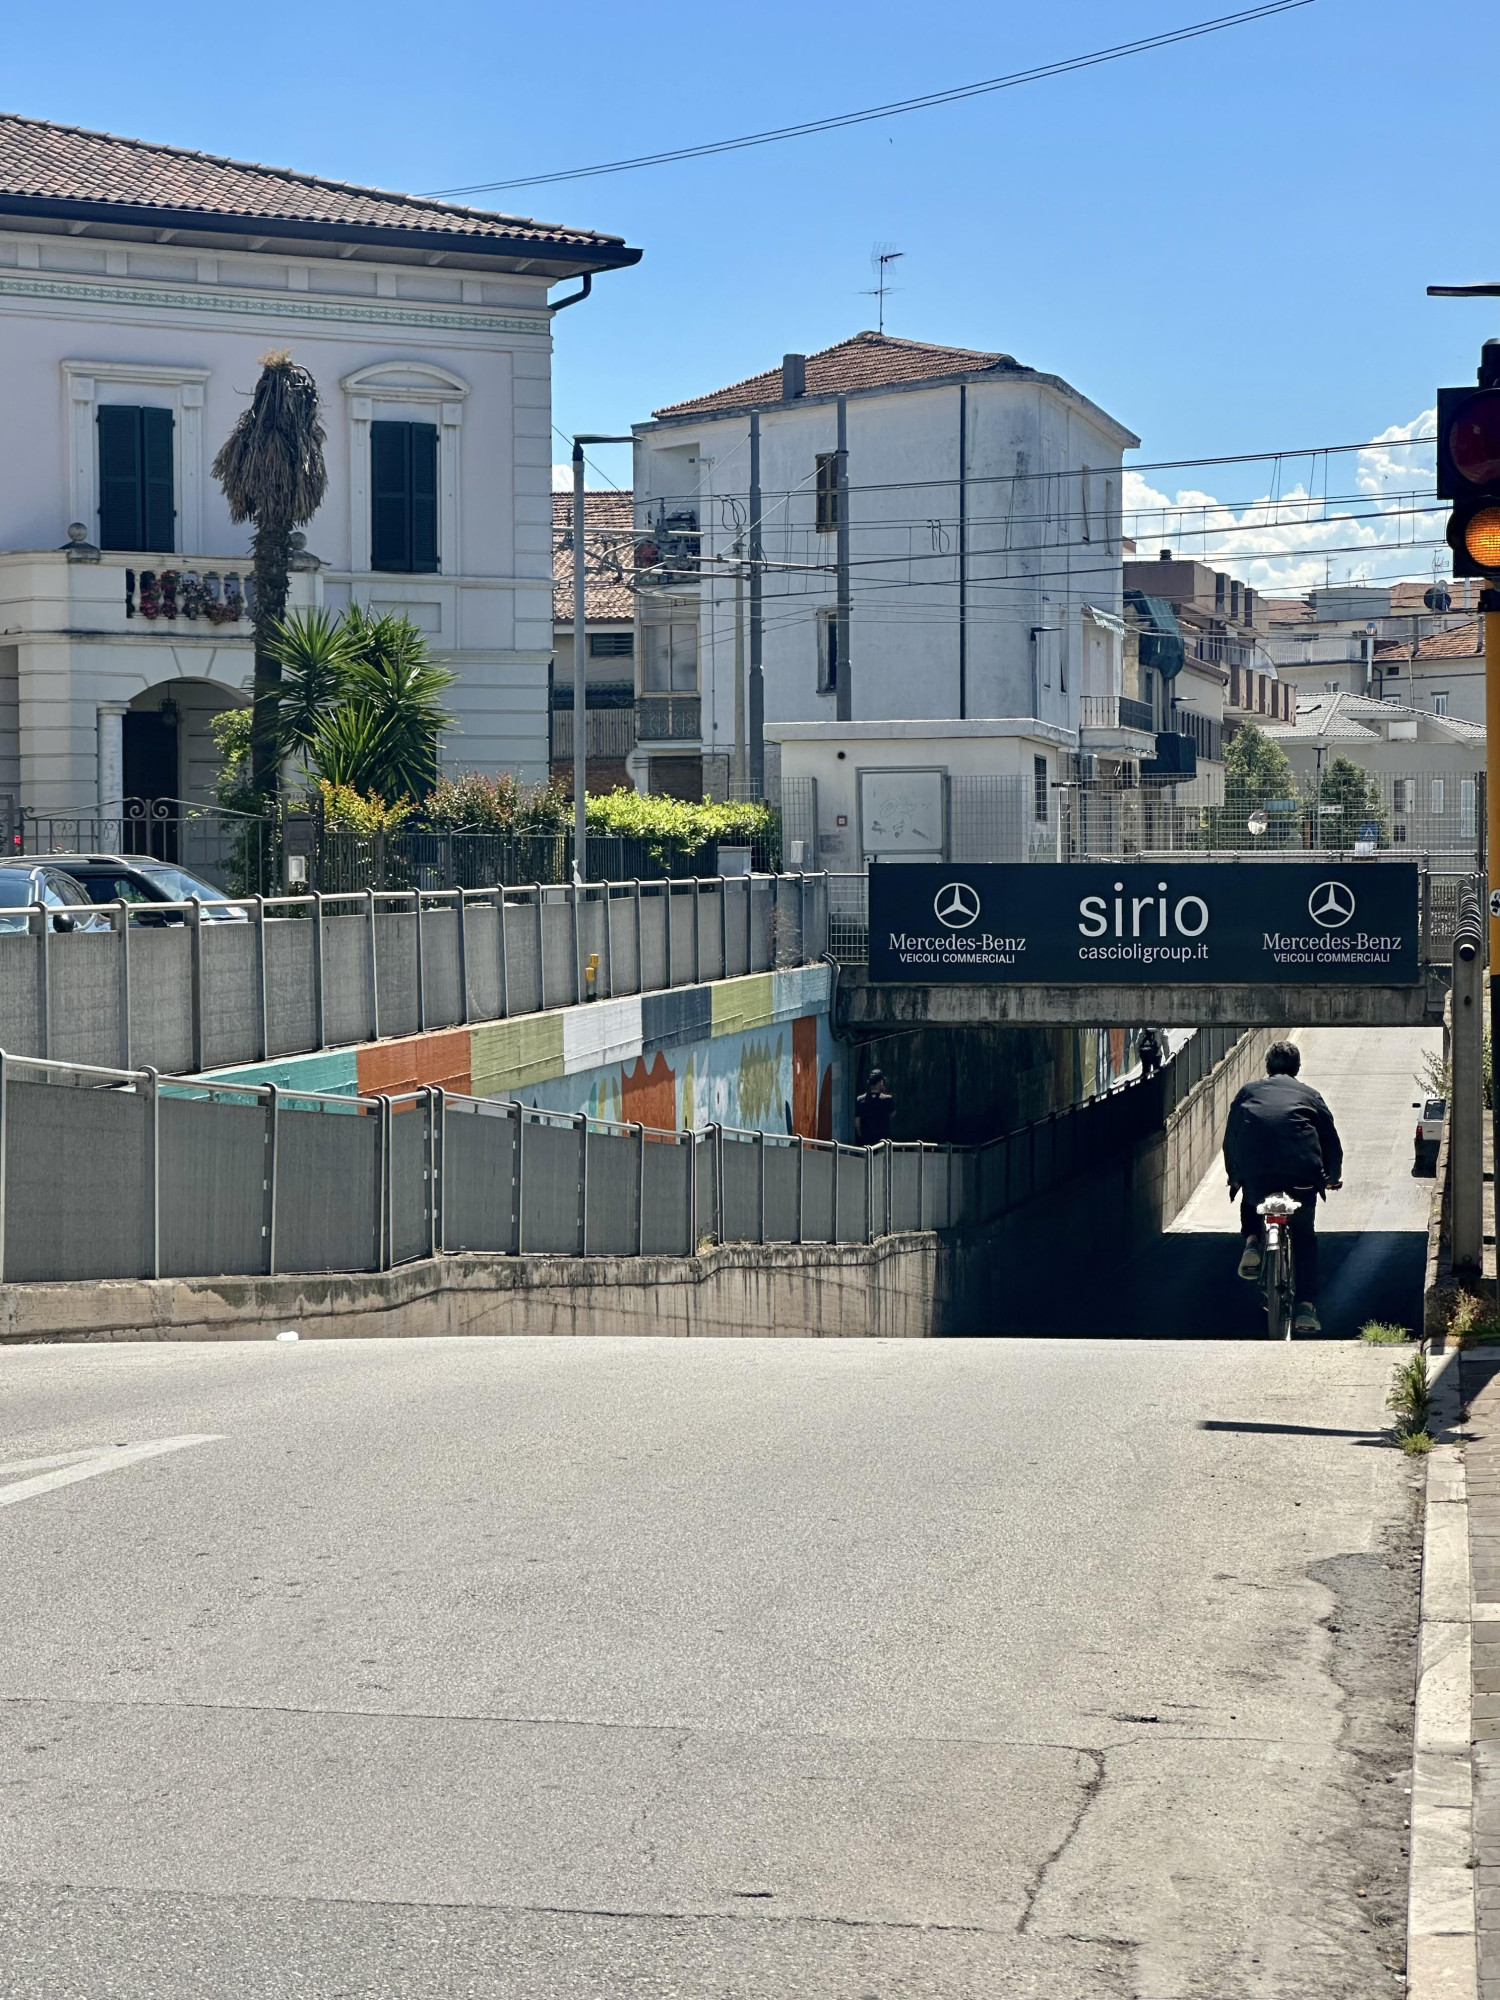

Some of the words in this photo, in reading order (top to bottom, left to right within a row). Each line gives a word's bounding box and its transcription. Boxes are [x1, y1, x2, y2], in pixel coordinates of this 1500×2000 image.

[1078, 881, 1209, 937] sirio
[888, 933, 1026, 951] Mercedes-Benz
[1262, 932, 1402, 950] Mercedes-Benz
[899, 953, 939, 964] VEICOLI
[942, 953, 1015, 964] COMMERCIALI
[1078, 942, 1209, 963] cascioligroup.it
[1273, 952, 1313, 963] VEICOLI
[1316, 952, 1390, 963] COMMERCIALI
